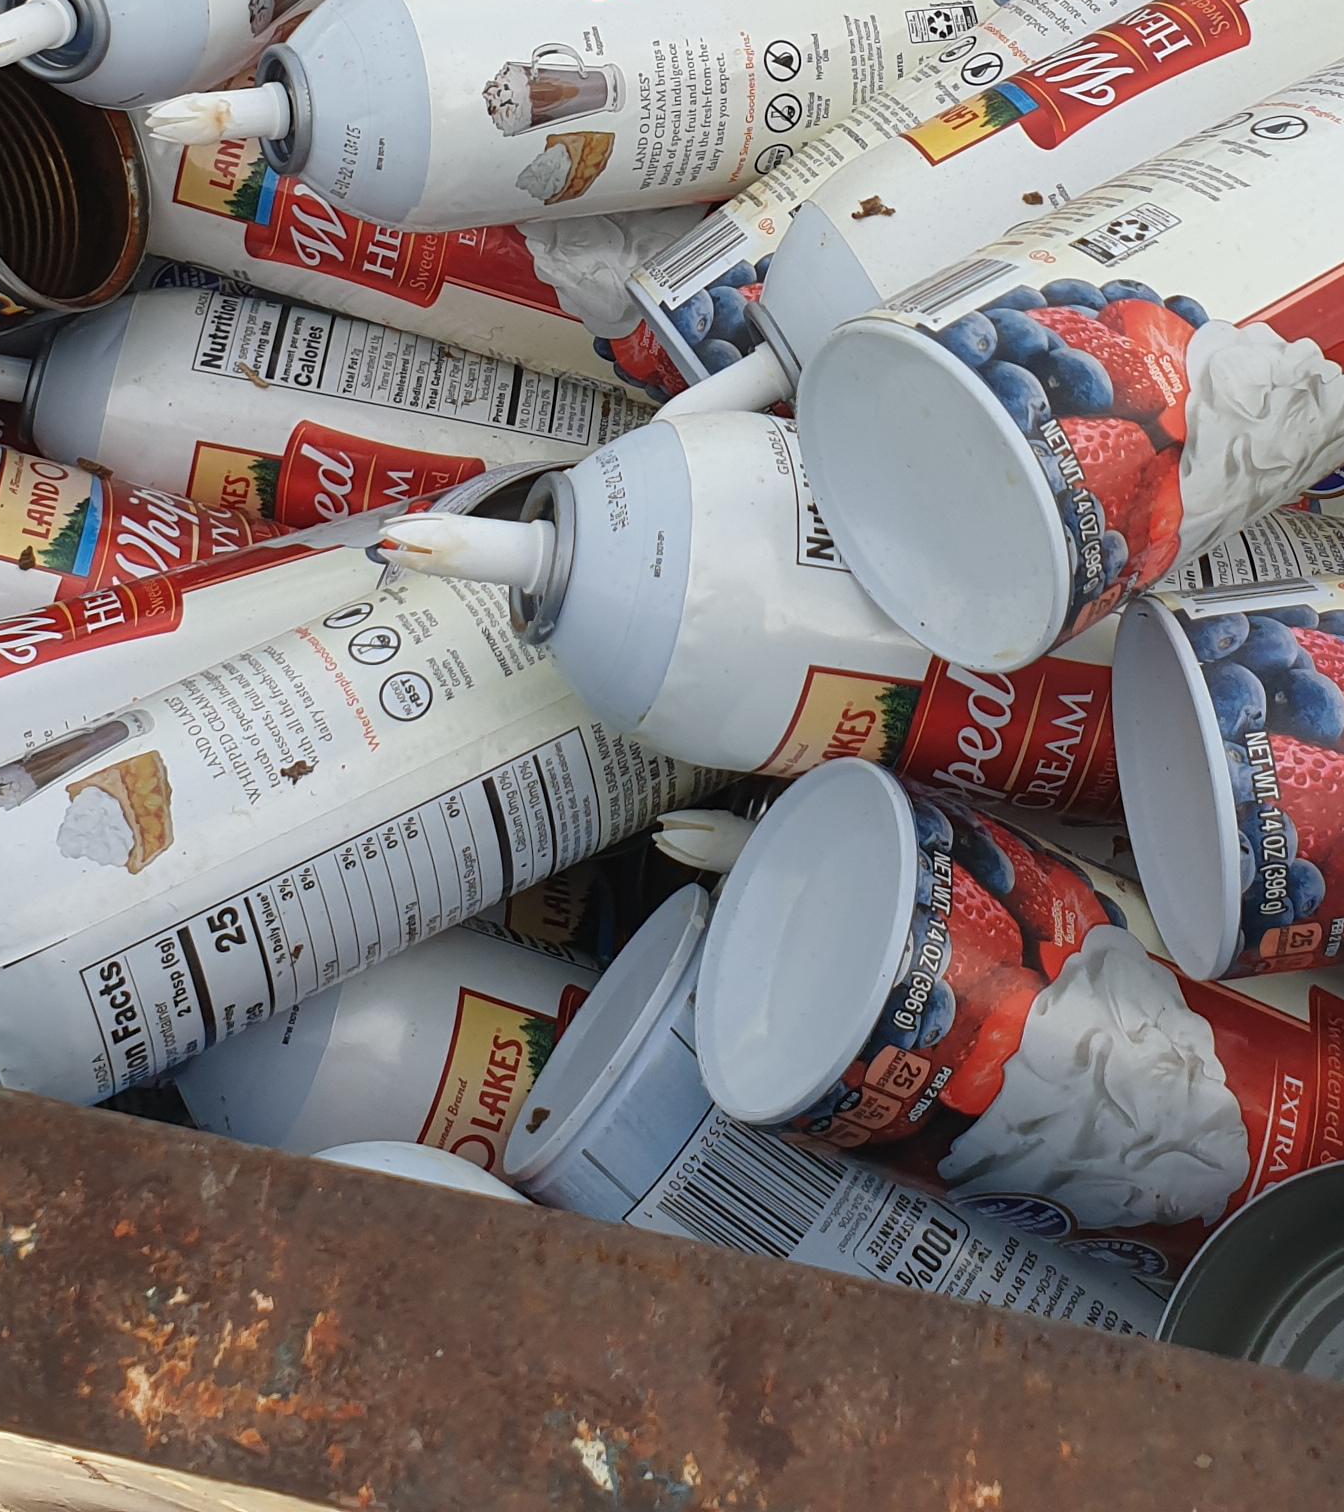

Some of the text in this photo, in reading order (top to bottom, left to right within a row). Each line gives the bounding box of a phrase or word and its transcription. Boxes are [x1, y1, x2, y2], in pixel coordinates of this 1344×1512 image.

[669, 43, 682, 146] special indulgence
[688, 50, 696, 82] more
[640, 50, 666, 189] WHIPPED CREAM brings
[685, 108, 696, 134] fruit
[707, 53, 730, 171] dairy taste you expect.
[729, 72, 756, 183] Where Simple Goodness
[632, 137, 648, 171] LAND
[200, 293, 239, 369] Nutrition
[294, 325, 324, 388] Calories
[1143, 354, 1176, 407] Suggestion
[1158, 355, 1183, 393] Serving
[22, 483, 58, 540] LAND
[1040, 418, 1098, 539] NET WT. 14 OZ
[1245, 731, 1287, 916] NET WT. 14 OZ (396 g)
[206, 906, 248, 953] 25
[893, 851, 952, 1031] NET WT. 14 OZ (396 g)
[97, 960, 143, 1046] Facts
[479, 1032, 524, 1133] LAKES
[892, 1059, 922, 1091] 25
[909, 1098, 932, 1122] TBSP
[866, 1194, 911, 1257] GUARANTEE
[876, 1197, 927, 1272] SATISFACTION
[896, 1217, 958, 1290] 100%
